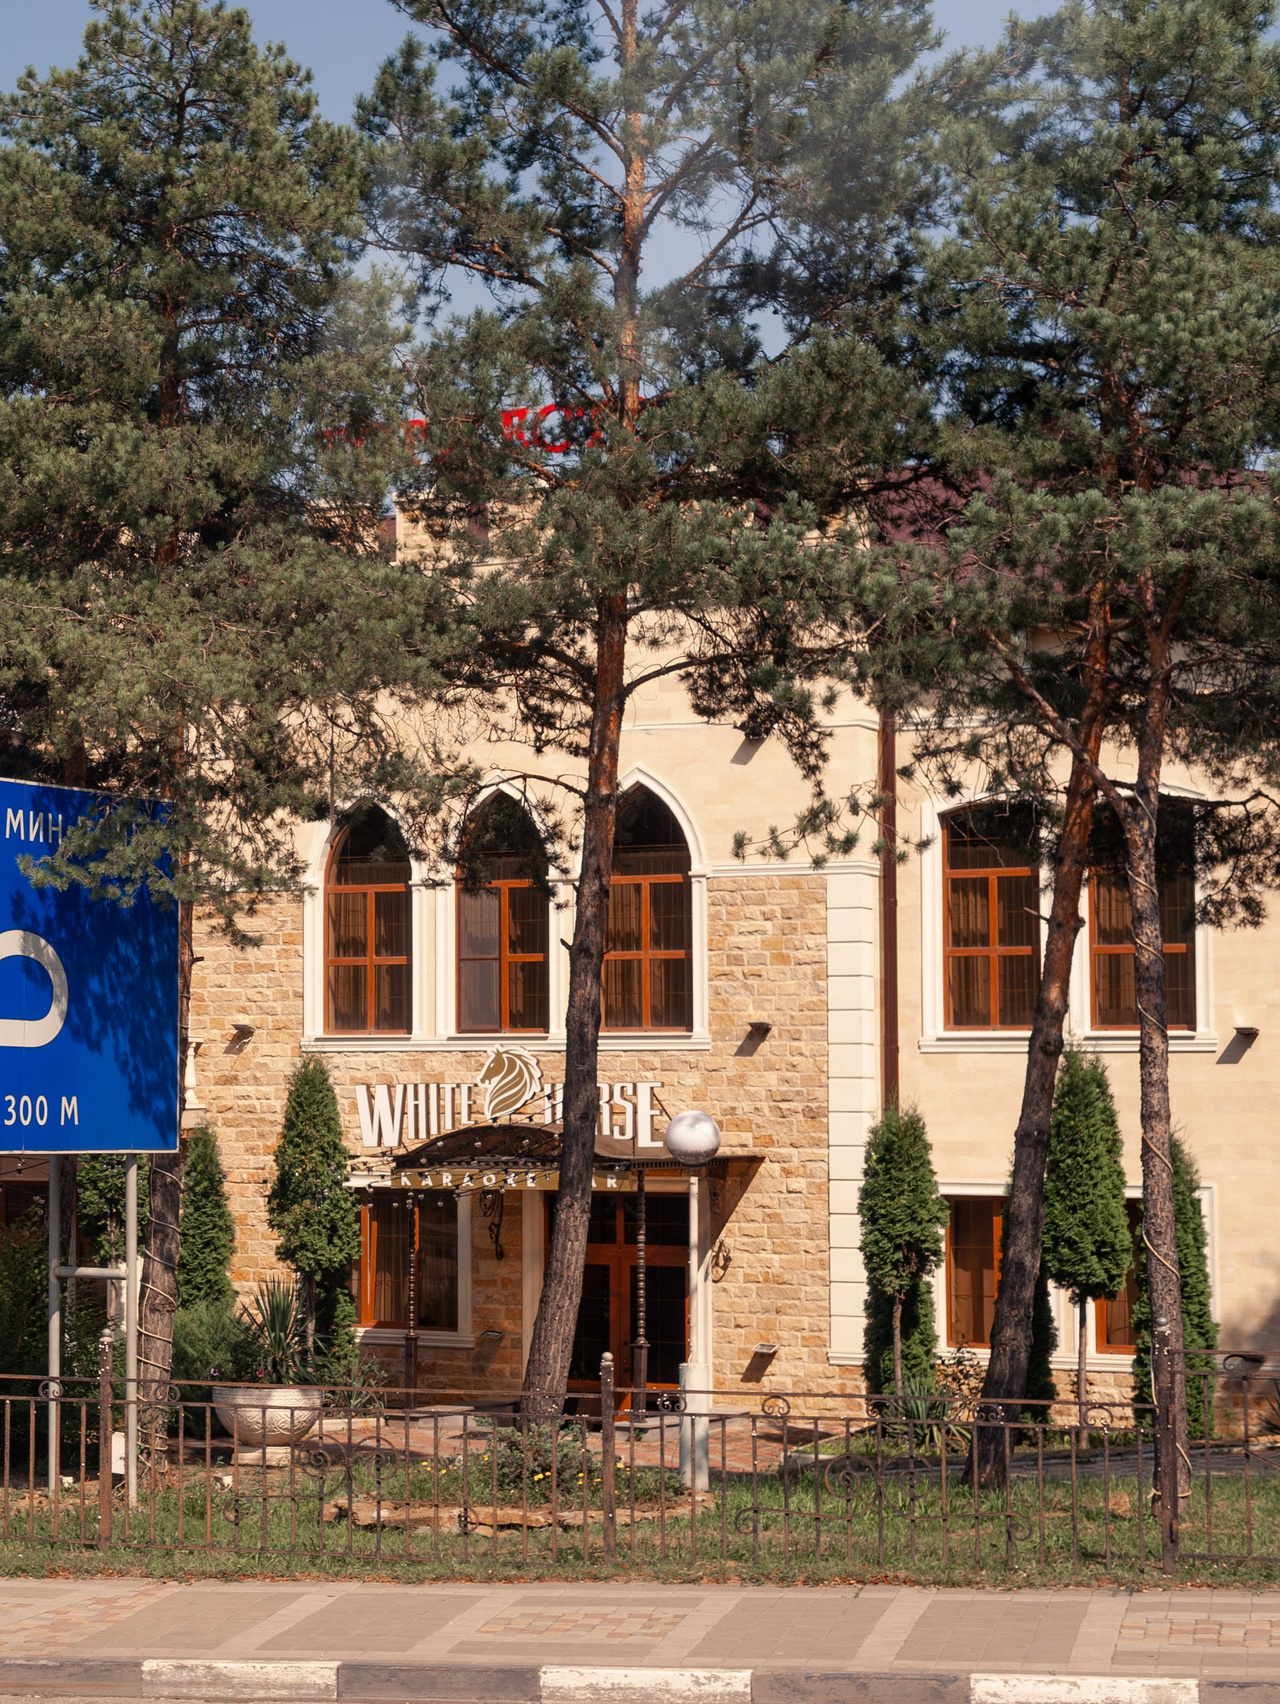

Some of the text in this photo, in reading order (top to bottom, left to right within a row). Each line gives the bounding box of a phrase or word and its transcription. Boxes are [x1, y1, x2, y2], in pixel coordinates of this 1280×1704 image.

[3, 1095, 48, 1126] 300
[355, 1082, 664, 1147] WHITE HRSE
[400, 1171, 537, 1188] KARAOKE
